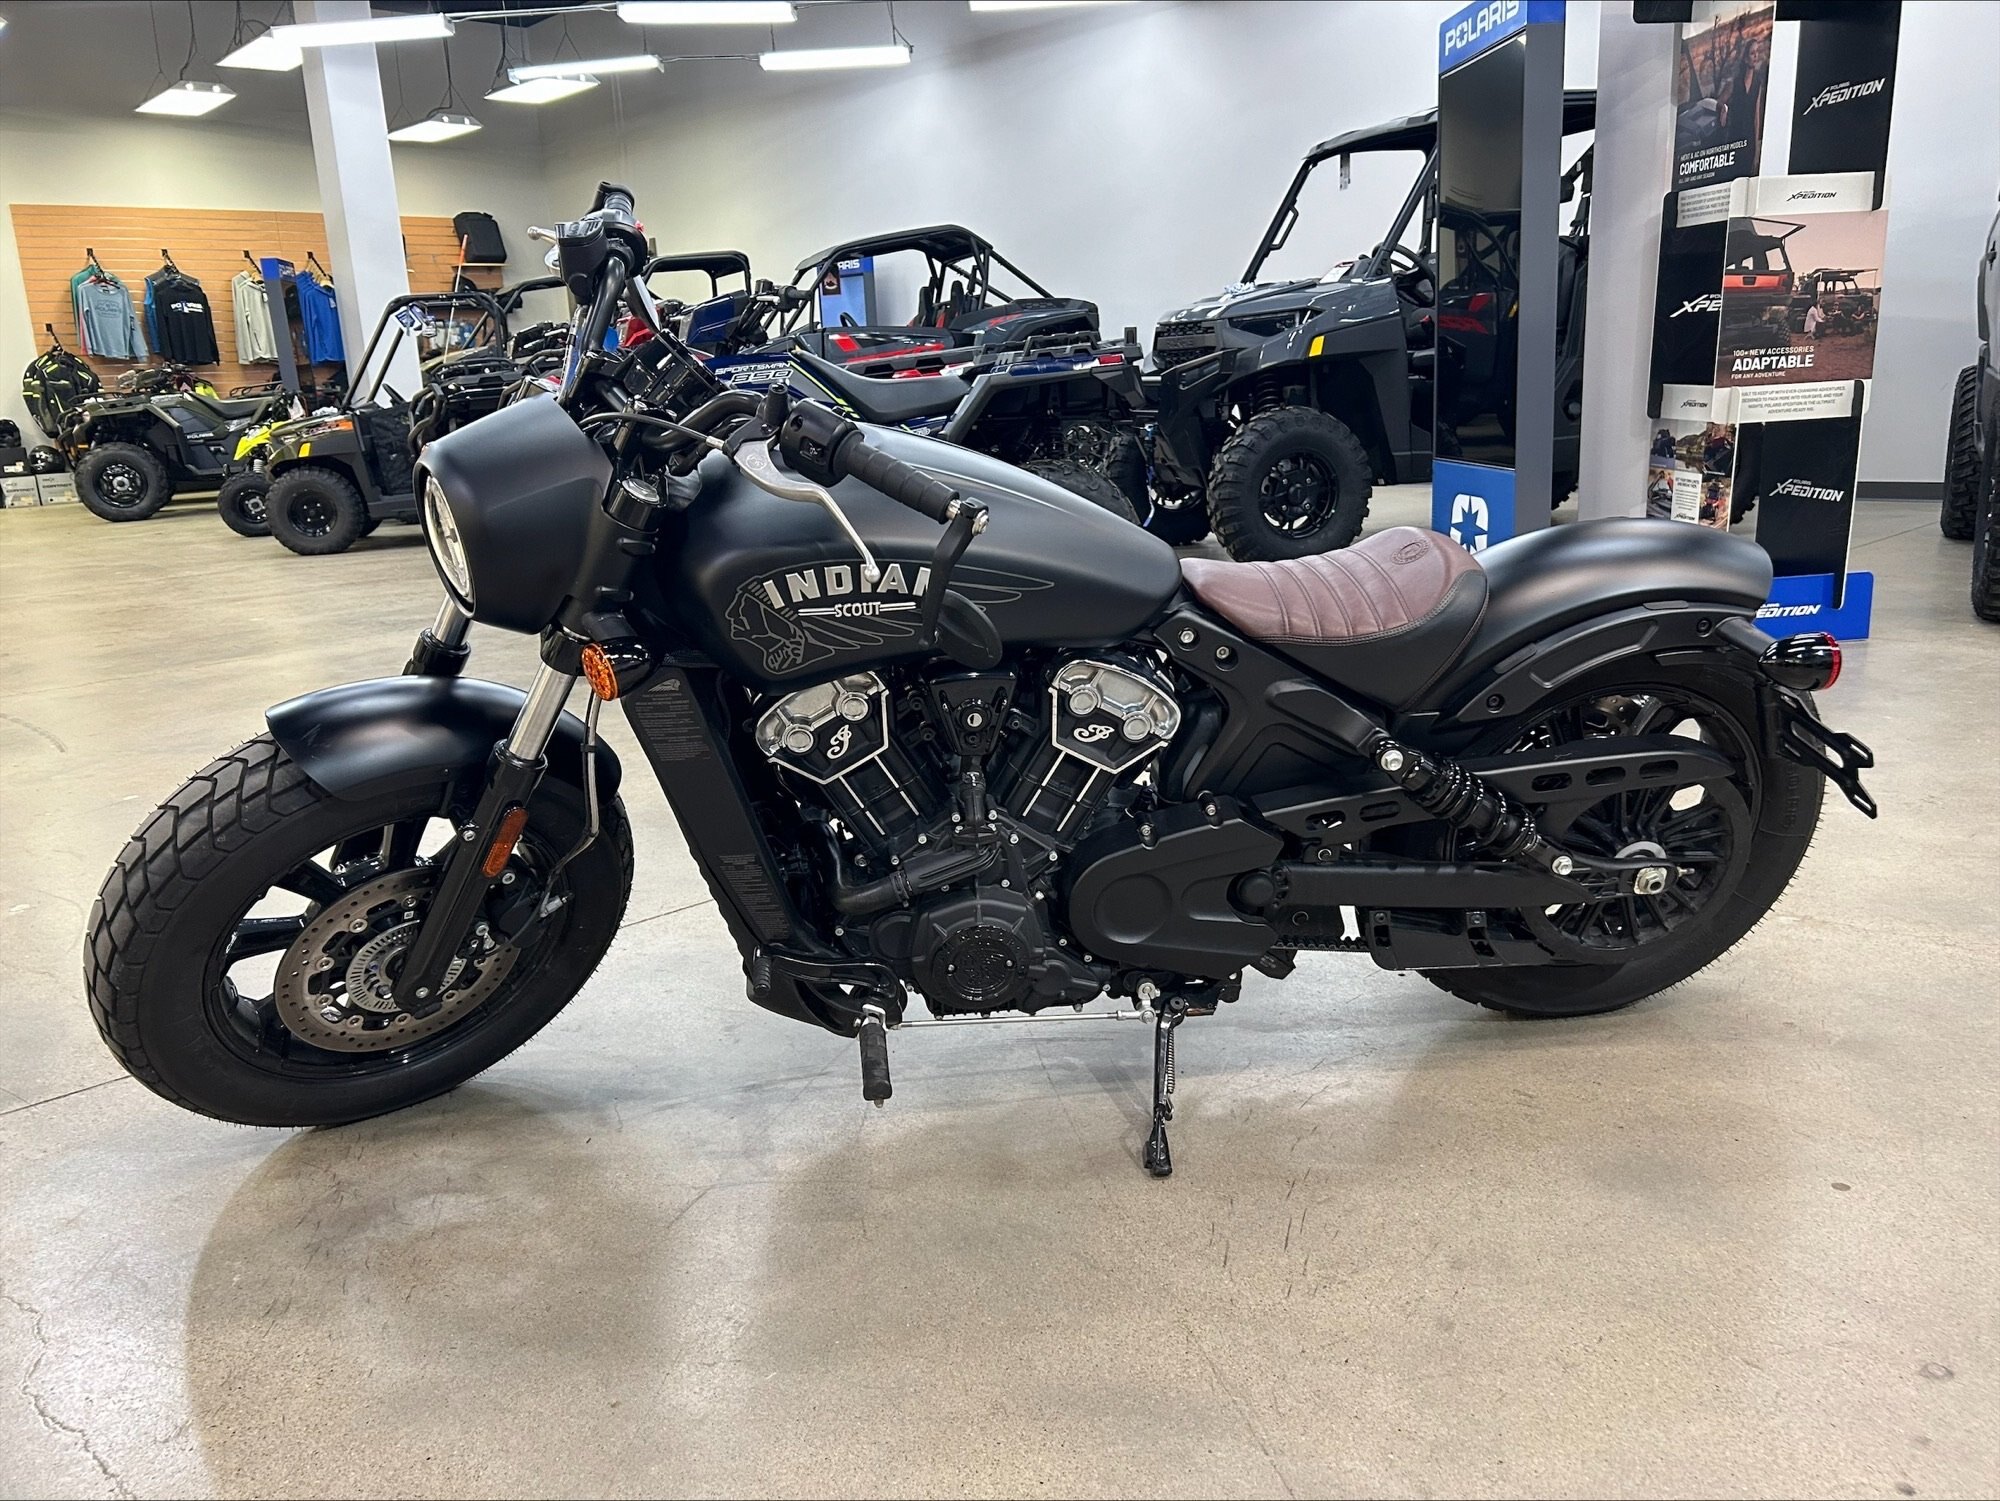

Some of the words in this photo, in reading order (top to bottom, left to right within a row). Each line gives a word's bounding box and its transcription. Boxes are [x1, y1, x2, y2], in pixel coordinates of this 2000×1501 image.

[1445, 1, 1519, 56] POLARIS
[1803, 78, 1886, 115] XPEDITION
[1680, 151, 1736, 175] COMFORTABLE
[1786, 191, 1837, 201] XPEDITION
[1670, 294, 1722, 317] XPE
[1767, 346, 1814, 355] ACCESSORIES
[715, 361, 790, 375] SPORTSMAN
[1732, 354, 1815, 372] ADAPTABLE
[730, 369, 793, 385] 850
[1768, 478, 1844, 502] XPEDITION
[834, 602, 880, 617] SCOUT
[1756, 604, 1821, 618] EDITION
